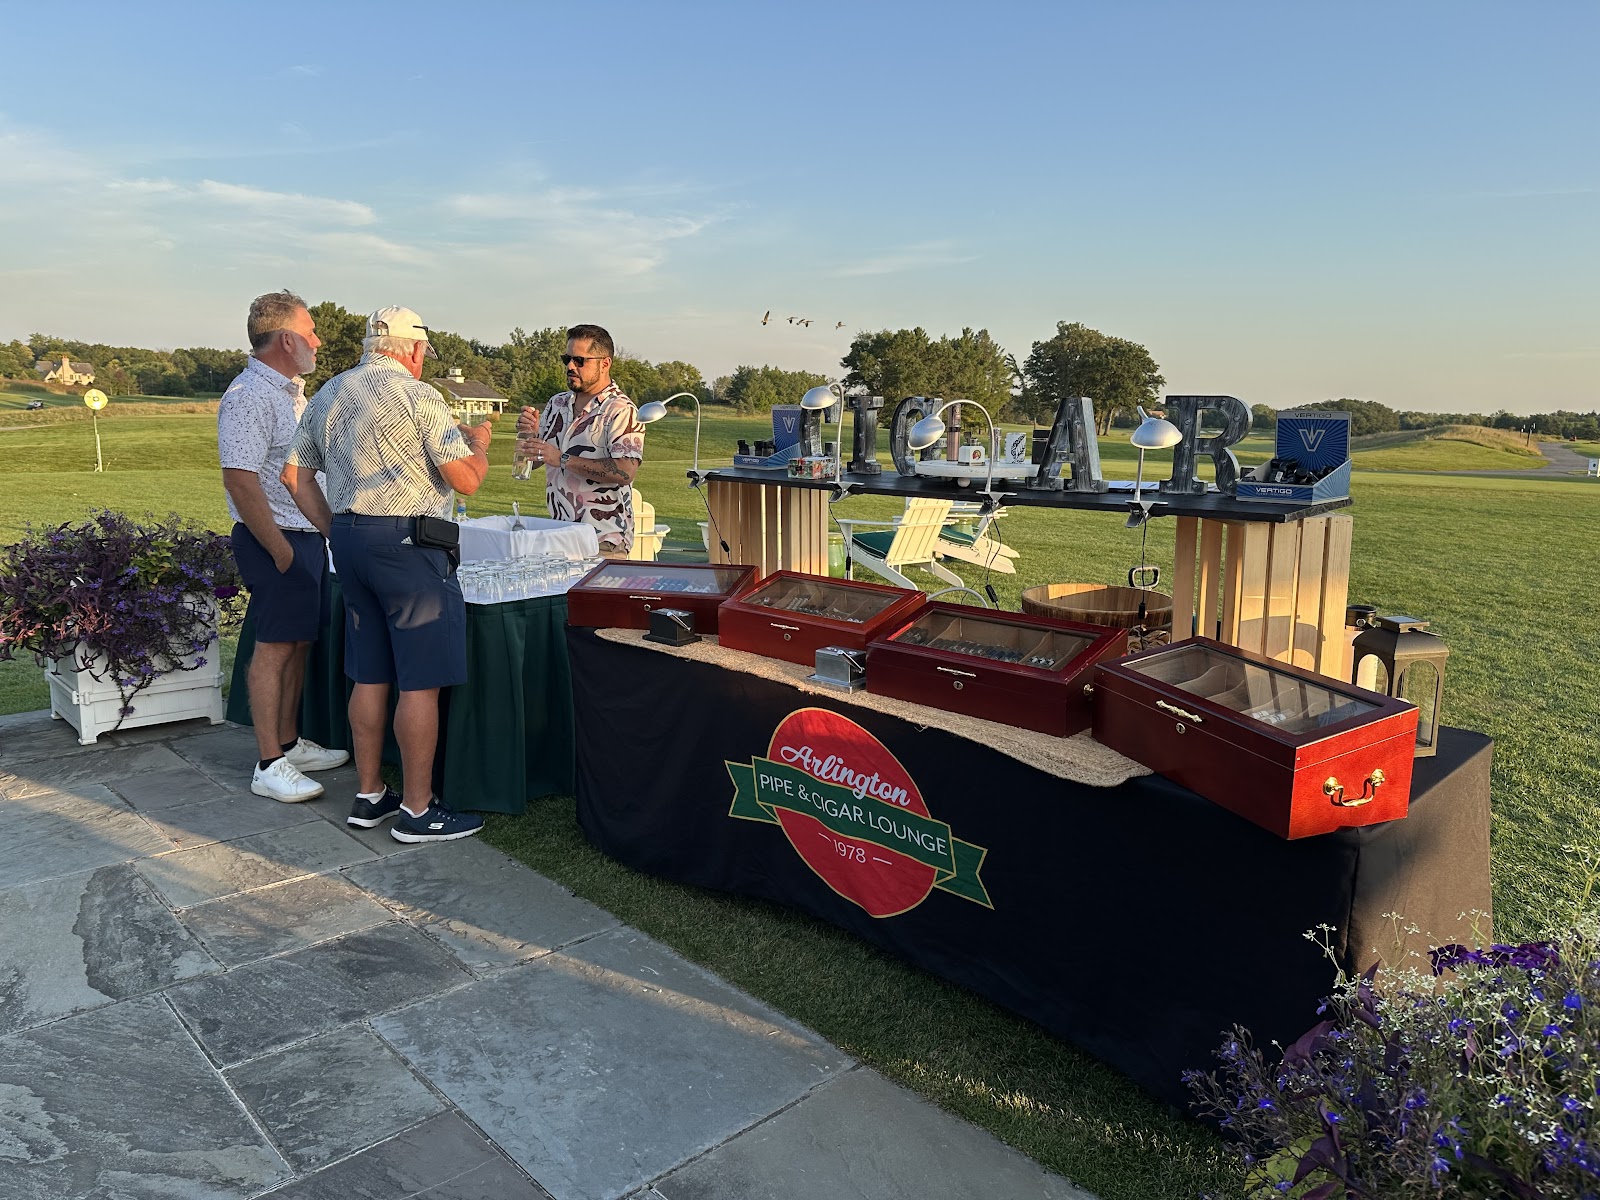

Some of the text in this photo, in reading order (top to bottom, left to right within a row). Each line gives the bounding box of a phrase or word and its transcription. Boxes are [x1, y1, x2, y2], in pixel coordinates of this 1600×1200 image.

[780, 746, 911, 806] Arlington
[760, 773, 948, 857] PIPE & CIGAR LOUNGE
[833, 839, 867, 864] 1978
